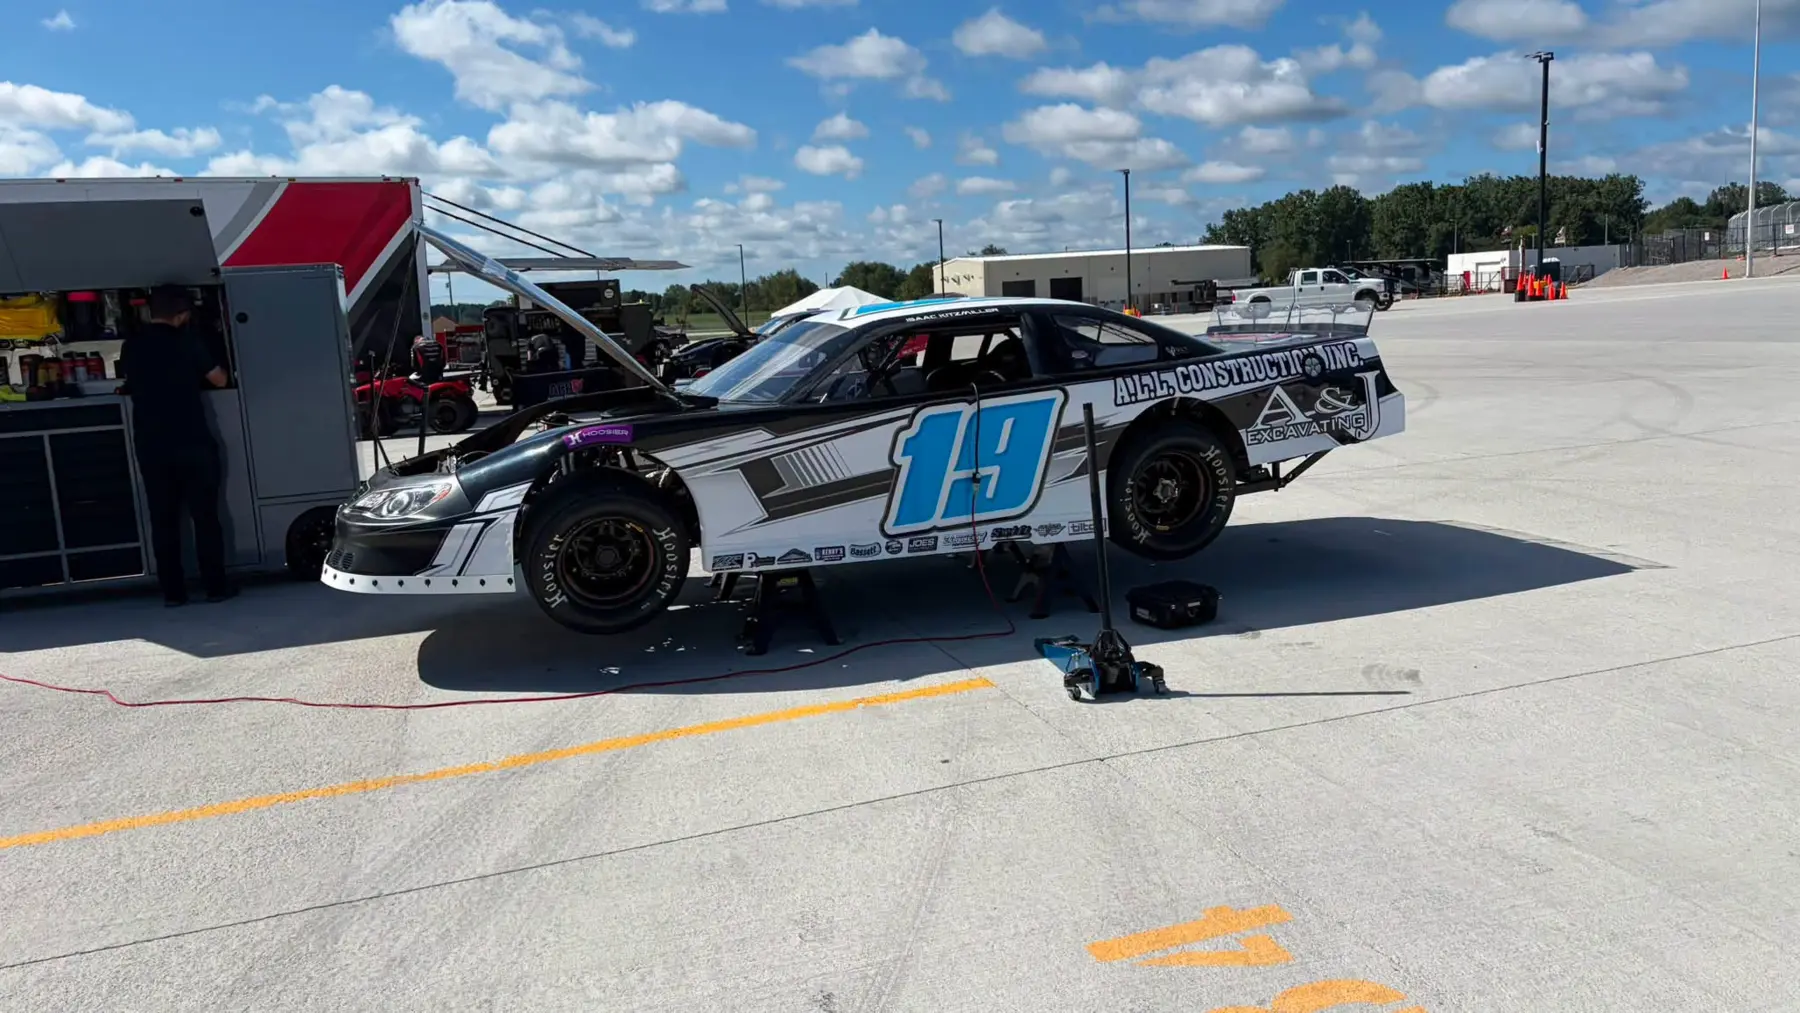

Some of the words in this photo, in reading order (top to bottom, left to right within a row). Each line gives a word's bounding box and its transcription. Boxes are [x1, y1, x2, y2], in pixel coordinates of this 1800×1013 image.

[905, 314, 937, 322] ISAAC
[938, 307, 999, 318] KITZMILLER
[1176, 345, 1318, 393] CONSTRUCTIO
[1323, 341, 1365, 371] INC.
[1246, 384, 1317, 432] A
[1314, 387, 1360, 415] &
[1354, 370, 1381, 441] J
[582, 428, 629, 438] HOOSIER
[1247, 410, 1366, 446] EXCAVATING
[885, 391, 1063, 533] 19
[850, 544, 877, 556] Bassett
[909, 538, 935, 548] JOES
